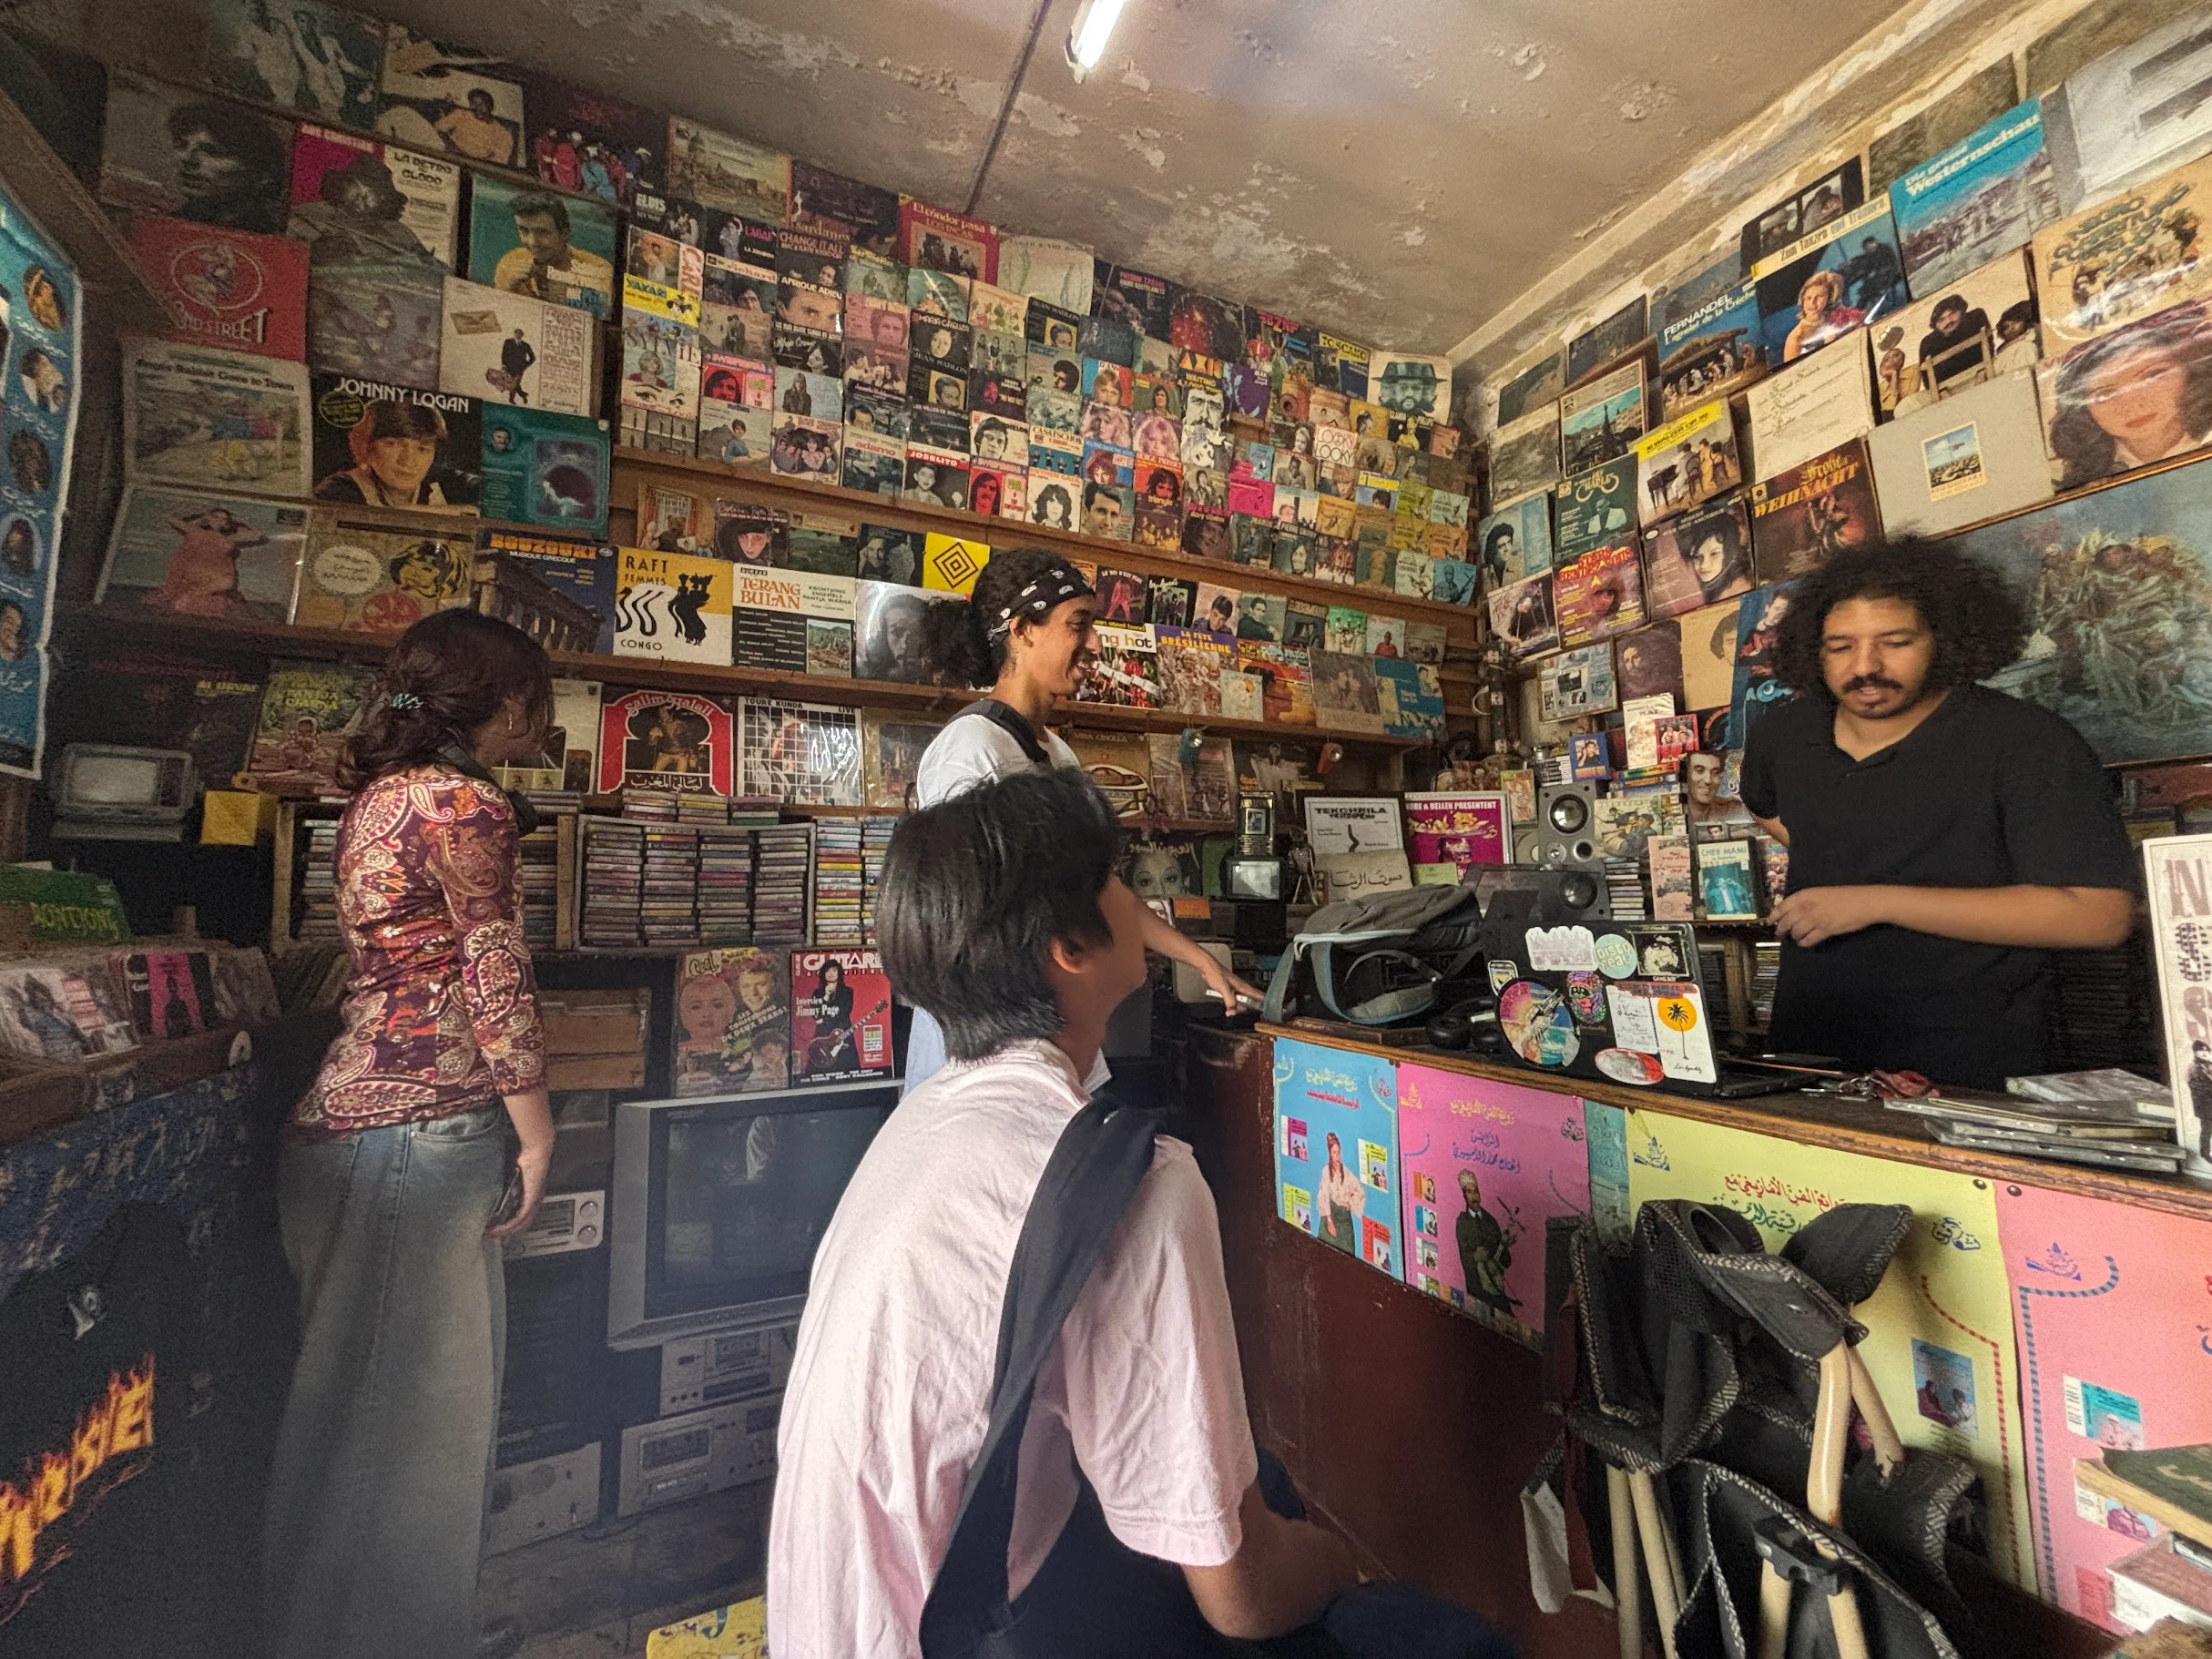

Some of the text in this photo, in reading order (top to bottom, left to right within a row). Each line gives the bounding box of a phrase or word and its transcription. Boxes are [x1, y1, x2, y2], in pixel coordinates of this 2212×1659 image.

[1779, 243, 1798, 262] Zum
[780, 276, 818, 292] AFRIQUE
[1663, 293, 1734, 339] FERNANDEL
[1185, 371, 1217, 388] WAITING
[333, 377, 470, 413] JOHNNY LOGAN
[854, 441, 897, 457] adamo
[1316, 443, 1353, 465] LOOKY
[909, 450, 958, 468] JOSELITO
[1753, 461, 1860, 528] WEIHNACHT
[490, 533, 597, 560] BOUZOUKI
[509, 550, 544, 562] MUSIQUE
[625, 555, 669, 574] RAFT
[624, 573, 668, 586] FEMMES
[739, 576, 801, 596] TERANG
[739, 589, 801, 610] BULAN
[620, 638, 663, 651] CONGO
[1124, 633, 1153, 650] hot
[747, 697, 857, 716] TOURE KUNDA LIVE
[1453, 800, 1497, 810] PRESENTENT
[1700, 846, 1748, 858] CHEB MAMI
[795, 1003, 841, 1020] Jimmy Page
[1787, 1183, 1816, 1207] الفن
